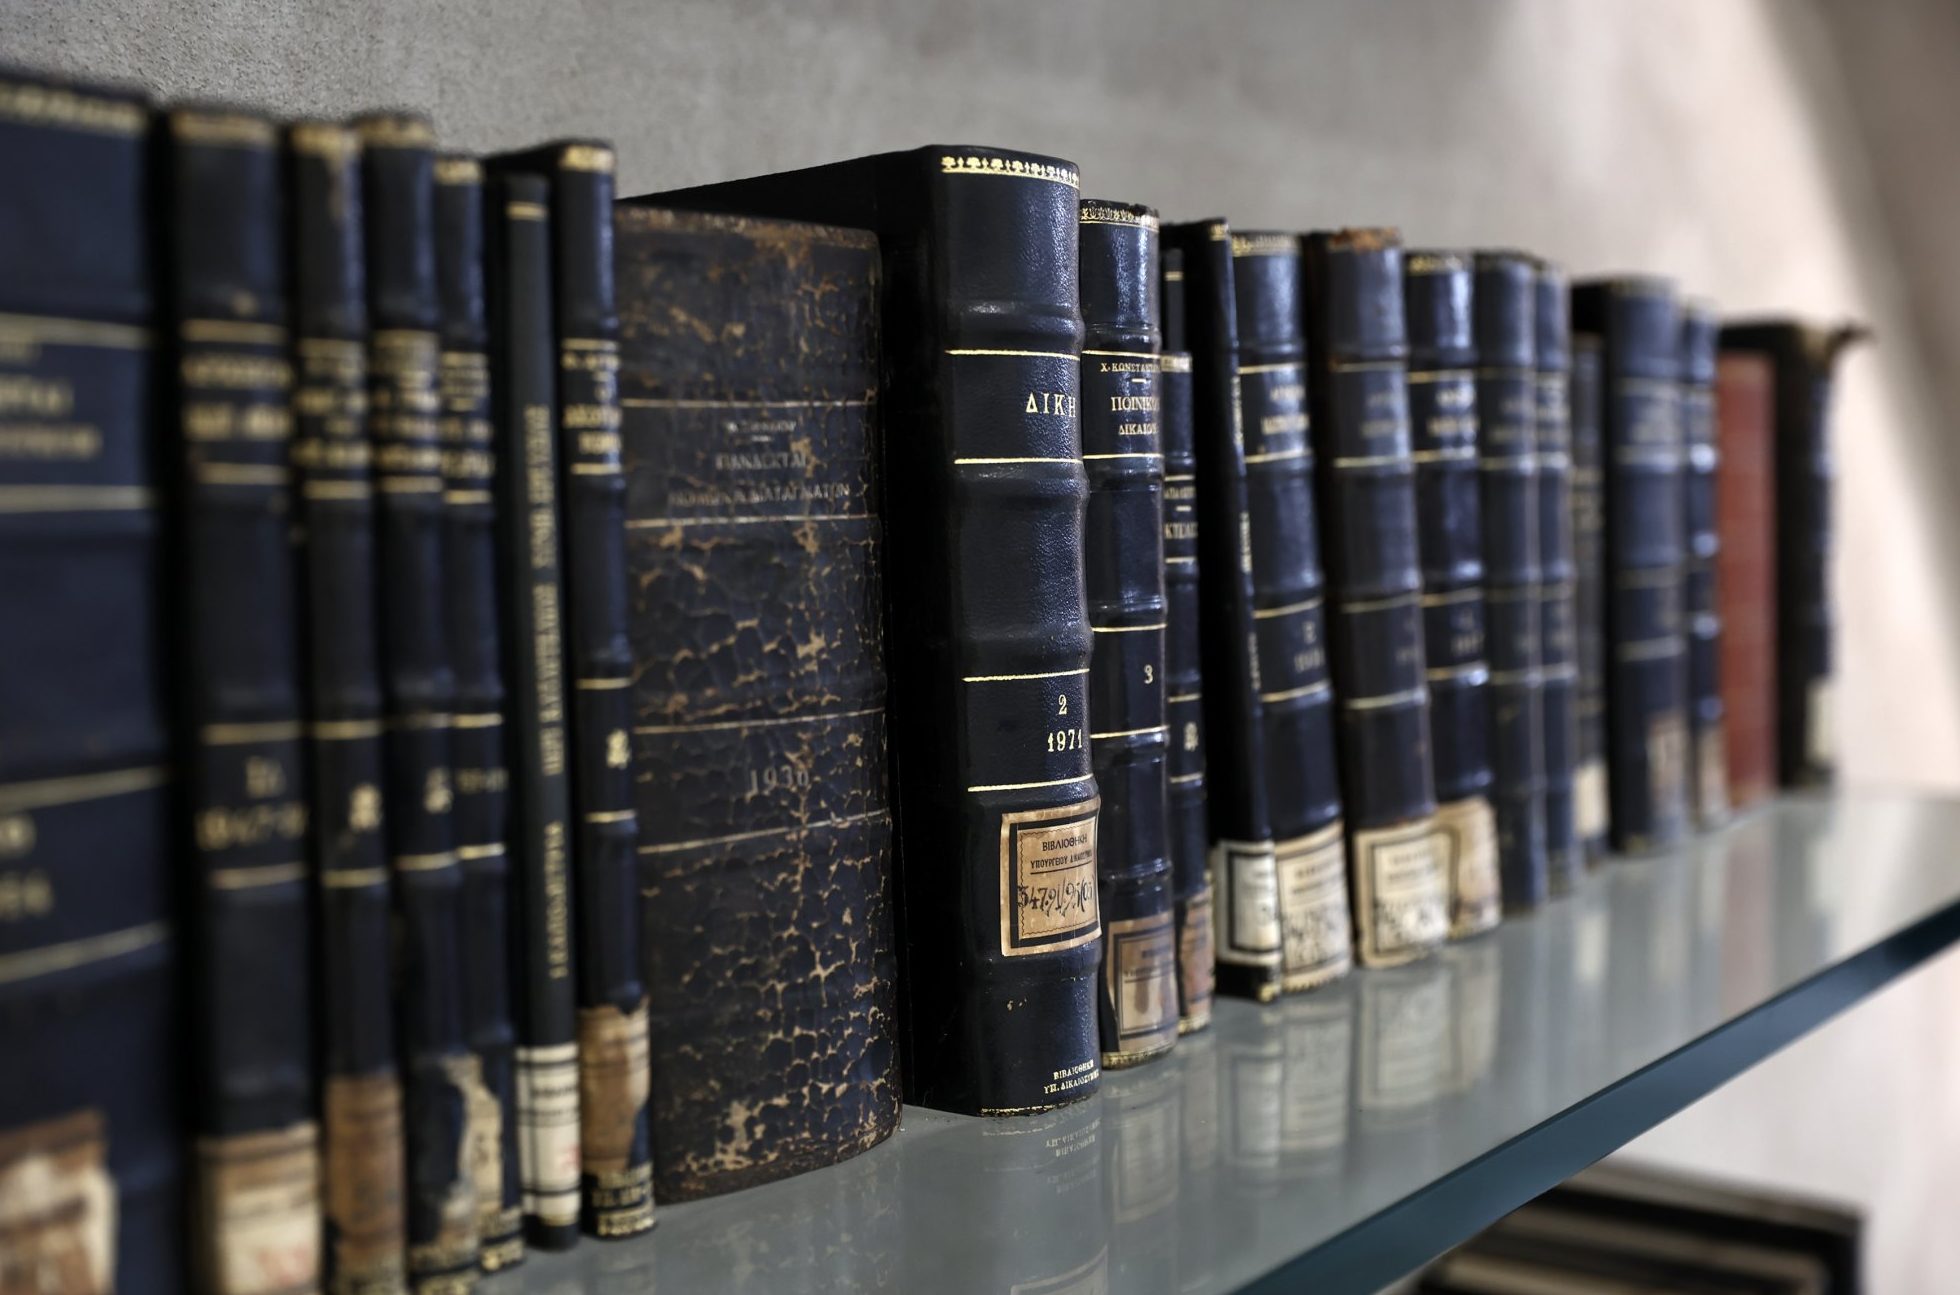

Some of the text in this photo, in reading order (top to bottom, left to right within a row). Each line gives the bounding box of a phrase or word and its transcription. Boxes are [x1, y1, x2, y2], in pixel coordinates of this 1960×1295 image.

[1026, 393, 1076, 418] ΔΙΚΗ
[1144, 664, 1154, 684] 3
[1058, 694, 1068, 715] 2
[1047, 729, 1083, 752] 1971
[1042, 834, 1088, 851] ΒΙΒΛΙΟΘΗΚΗ
